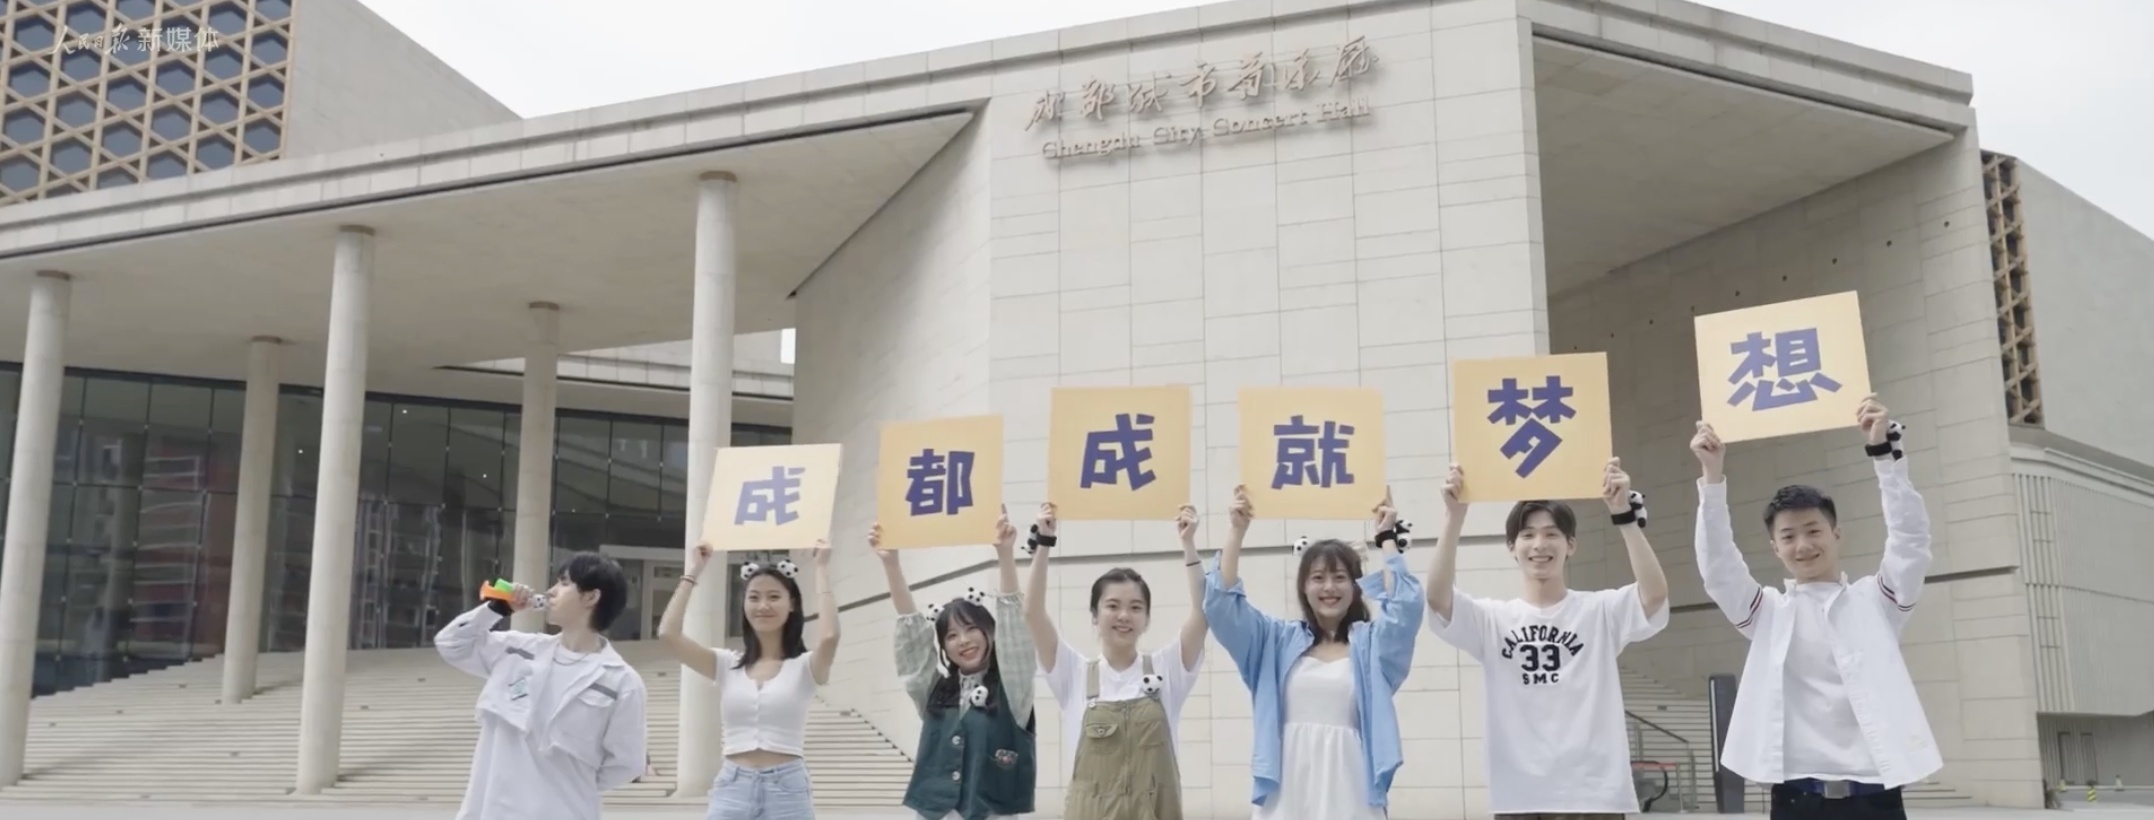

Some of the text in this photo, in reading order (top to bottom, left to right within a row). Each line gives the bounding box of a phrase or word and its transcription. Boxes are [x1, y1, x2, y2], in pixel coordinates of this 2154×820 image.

[1041, 97, 1371, 159] Chengdu City Concert Hall
[1727, 327, 1843, 412] 想
[1080, 413, 1157, 491] 成
[1272, 415, 1355, 489] 就
[1487, 376, 1577, 479] 梦
[735, 465, 806, 526] 成
[905, 448, 975, 518] 都
[1501, 625, 1584, 659] CALIFORNIA
[1519, 644, 1561, 672] 33
[1522, 673, 1559, 685] SMC
